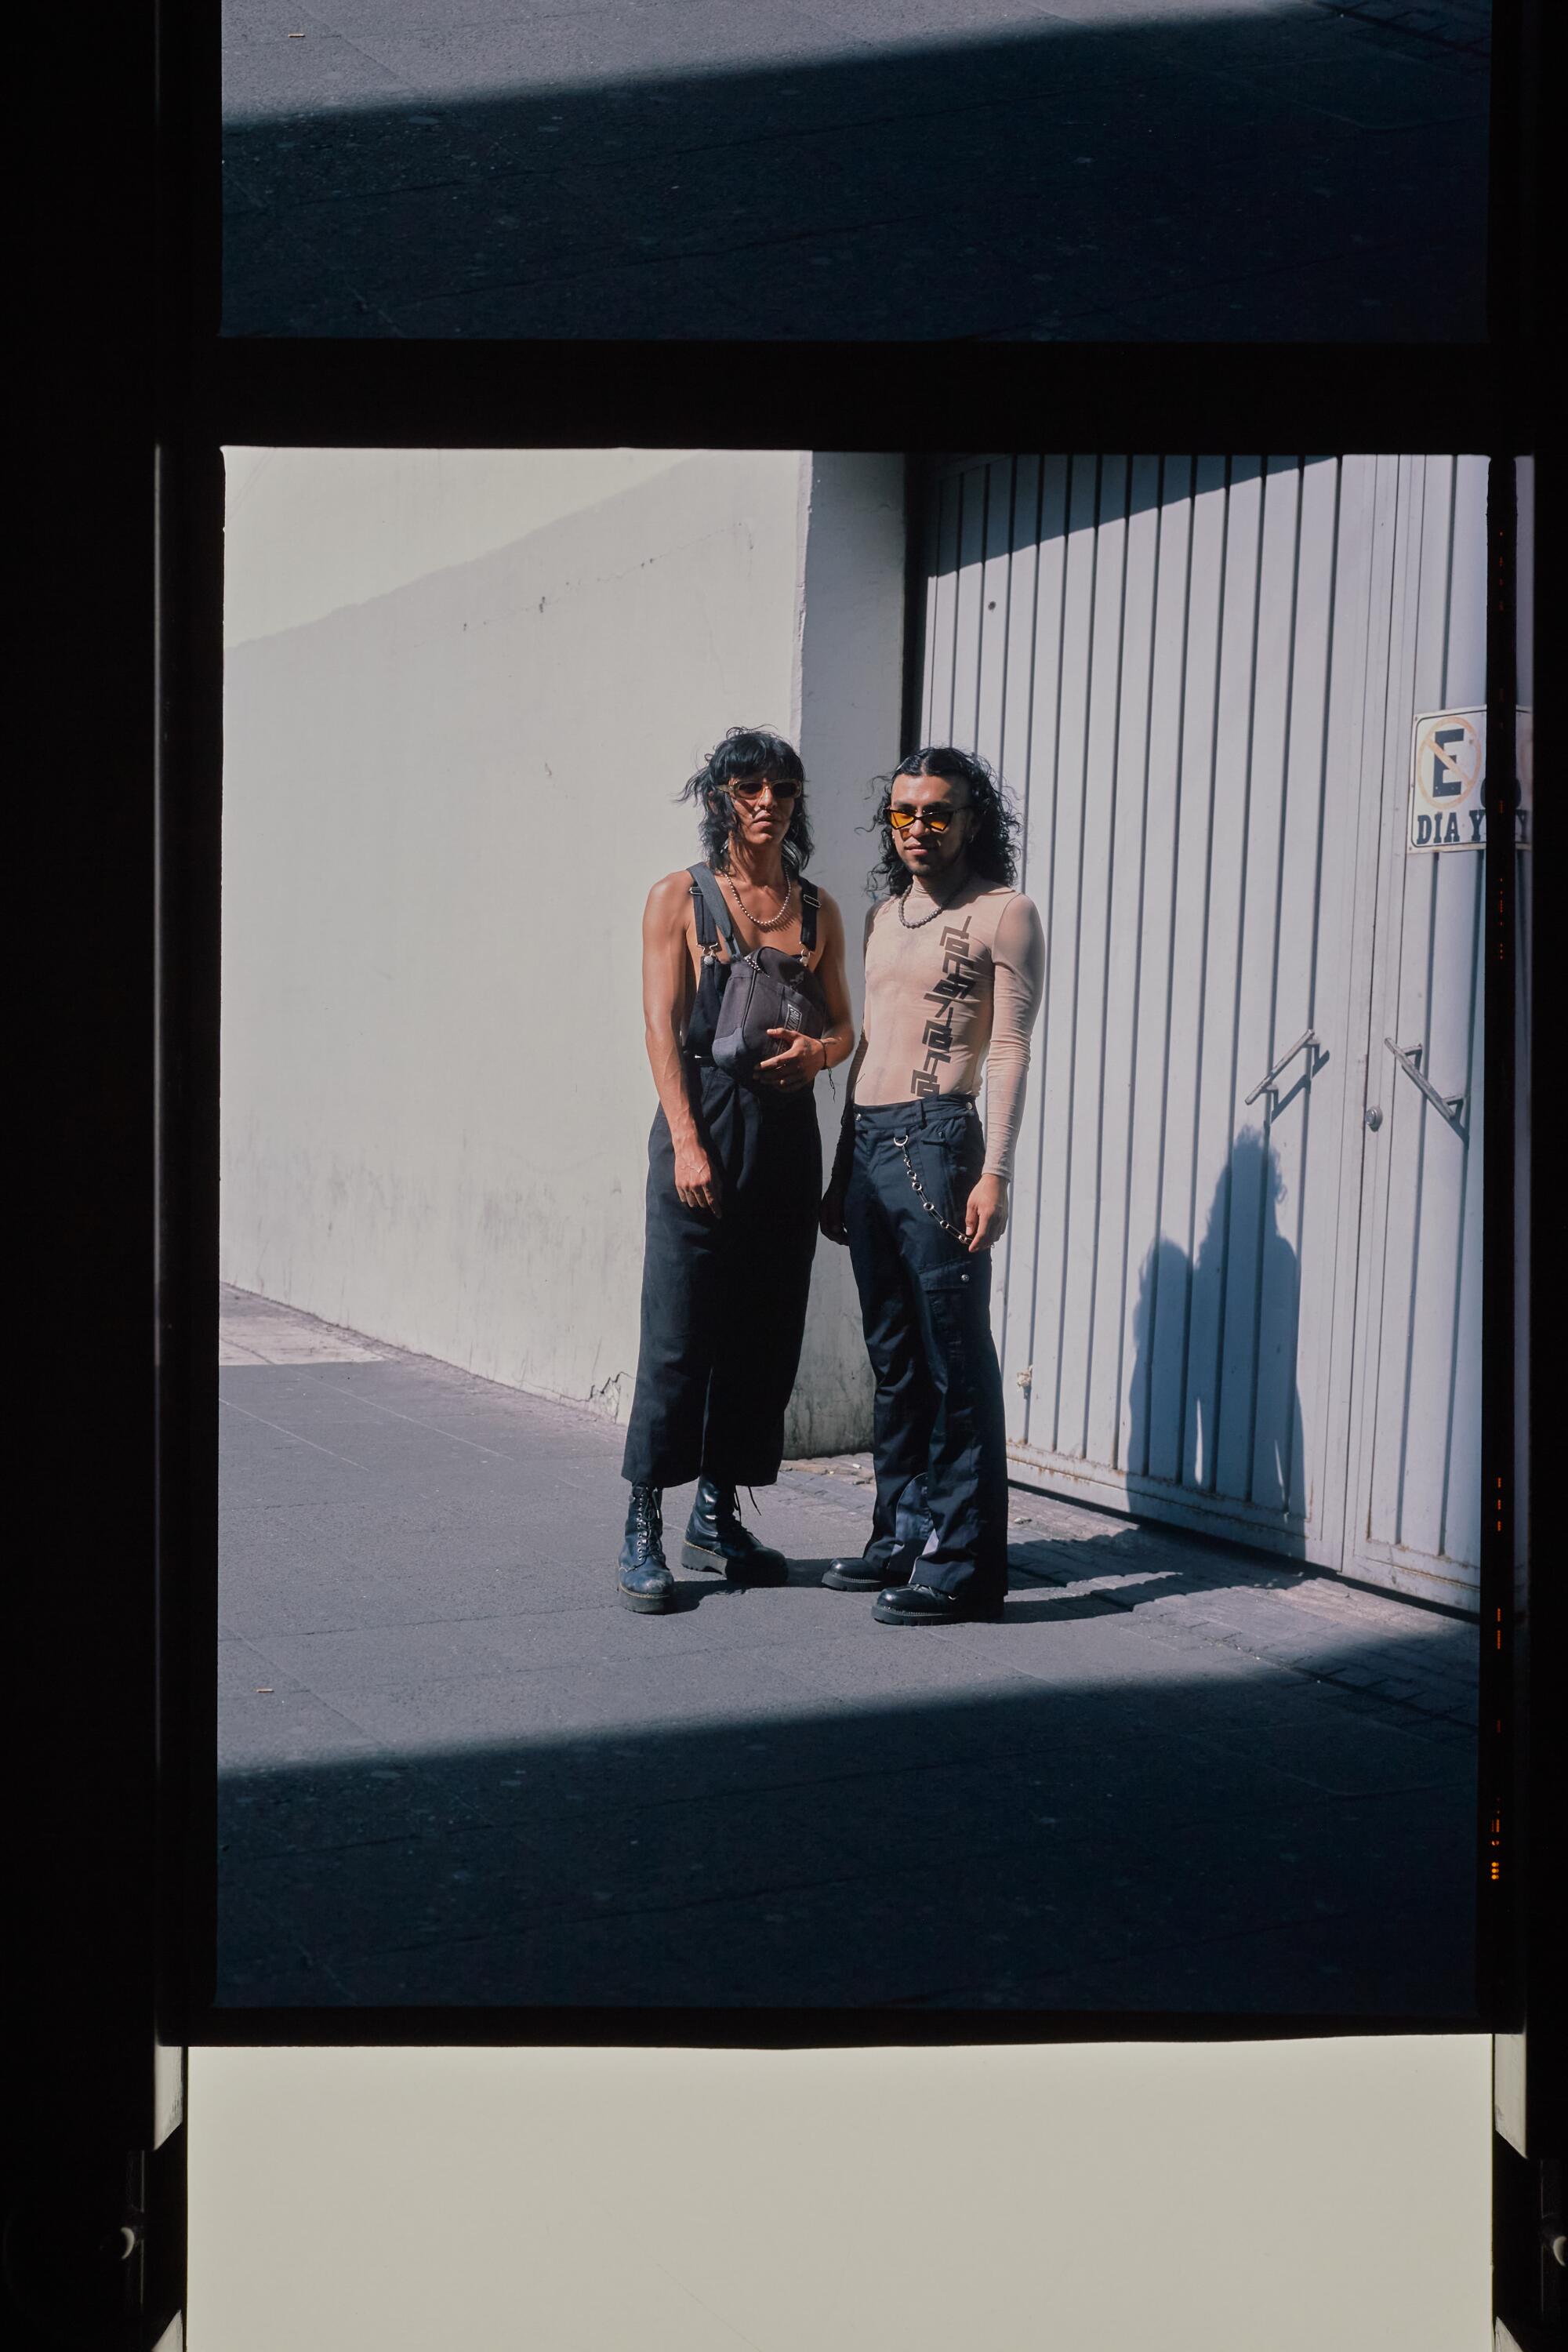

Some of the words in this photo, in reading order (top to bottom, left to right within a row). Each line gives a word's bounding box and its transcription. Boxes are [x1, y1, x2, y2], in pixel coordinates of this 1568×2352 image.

[1432, 728, 1465, 798] E
[1417, 811, 1460, 845] DIA
[1469, 809, 1486, 841] Y
